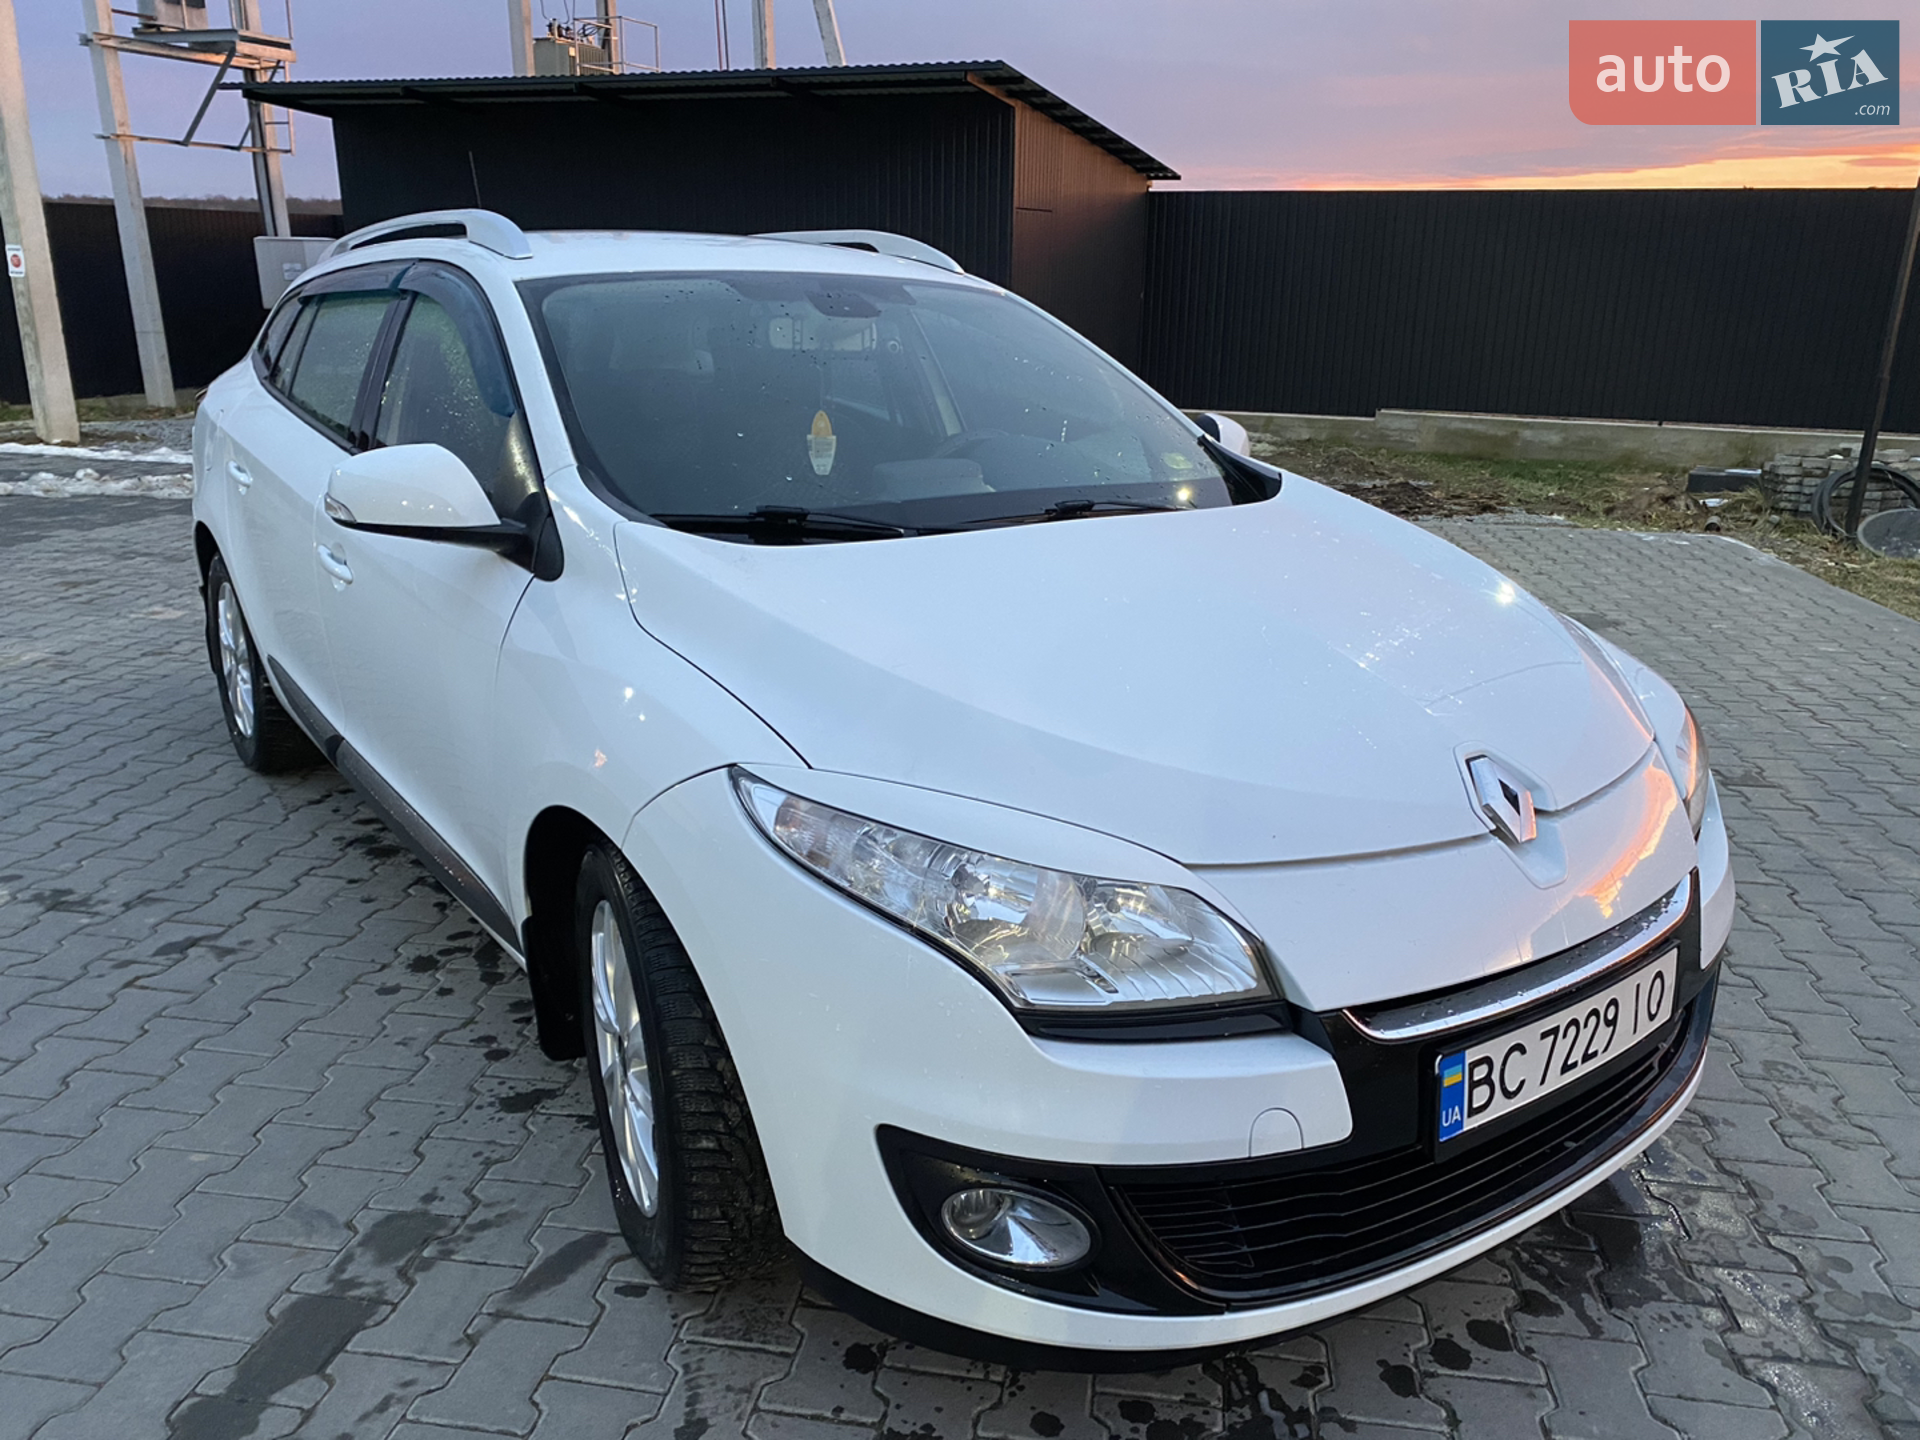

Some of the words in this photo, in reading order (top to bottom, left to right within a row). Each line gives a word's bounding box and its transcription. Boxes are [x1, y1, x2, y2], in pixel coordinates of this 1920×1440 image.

[1467, 1042, 1528, 1119] BC
[1539, 997, 1620, 1086] 7229
[1632, 969, 1665, 1036] IO
[1441, 1104, 1462, 1128] UA
